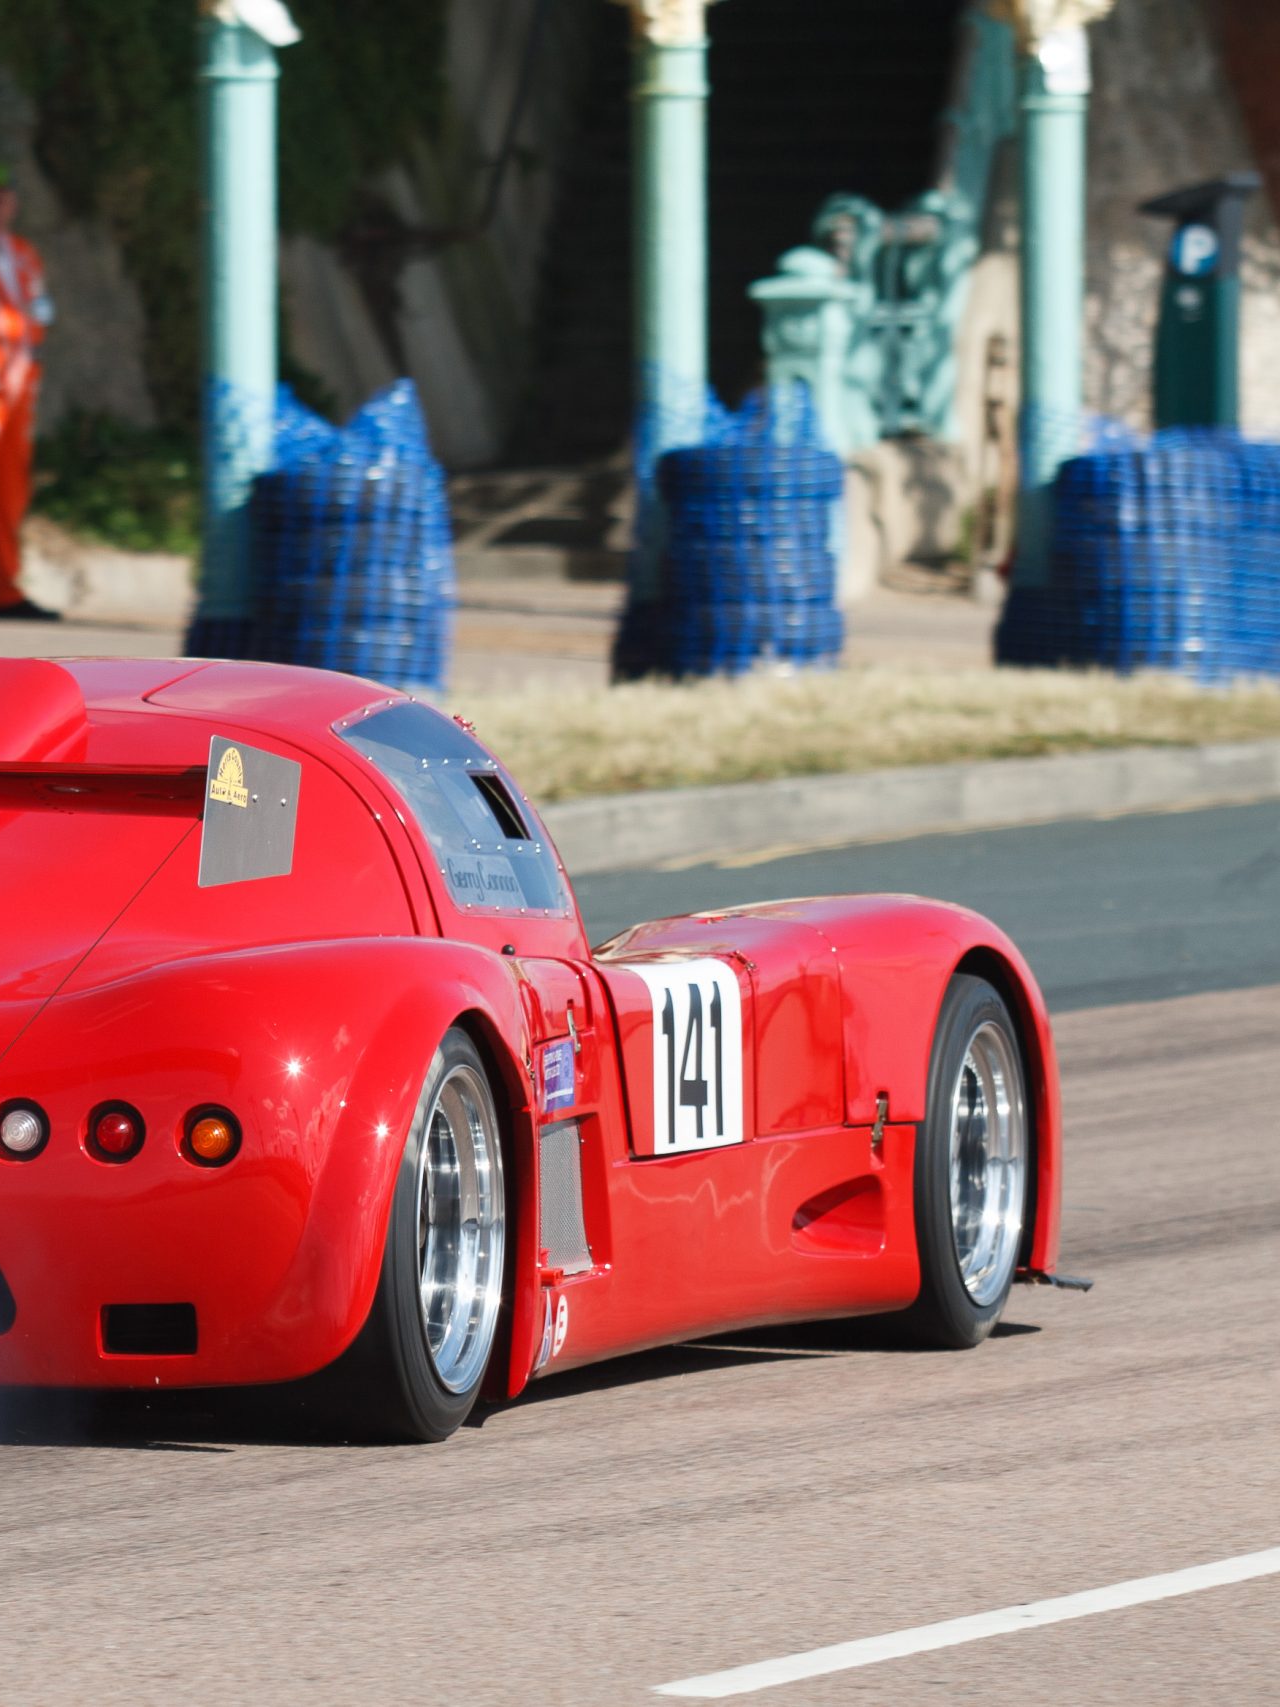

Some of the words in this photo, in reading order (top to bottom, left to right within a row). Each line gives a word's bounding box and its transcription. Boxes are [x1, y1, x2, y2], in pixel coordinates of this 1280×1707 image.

[1181, 226, 1214, 274] P
[233, 790, 246, 803] Aero
[662, 981, 723, 1144] 141
